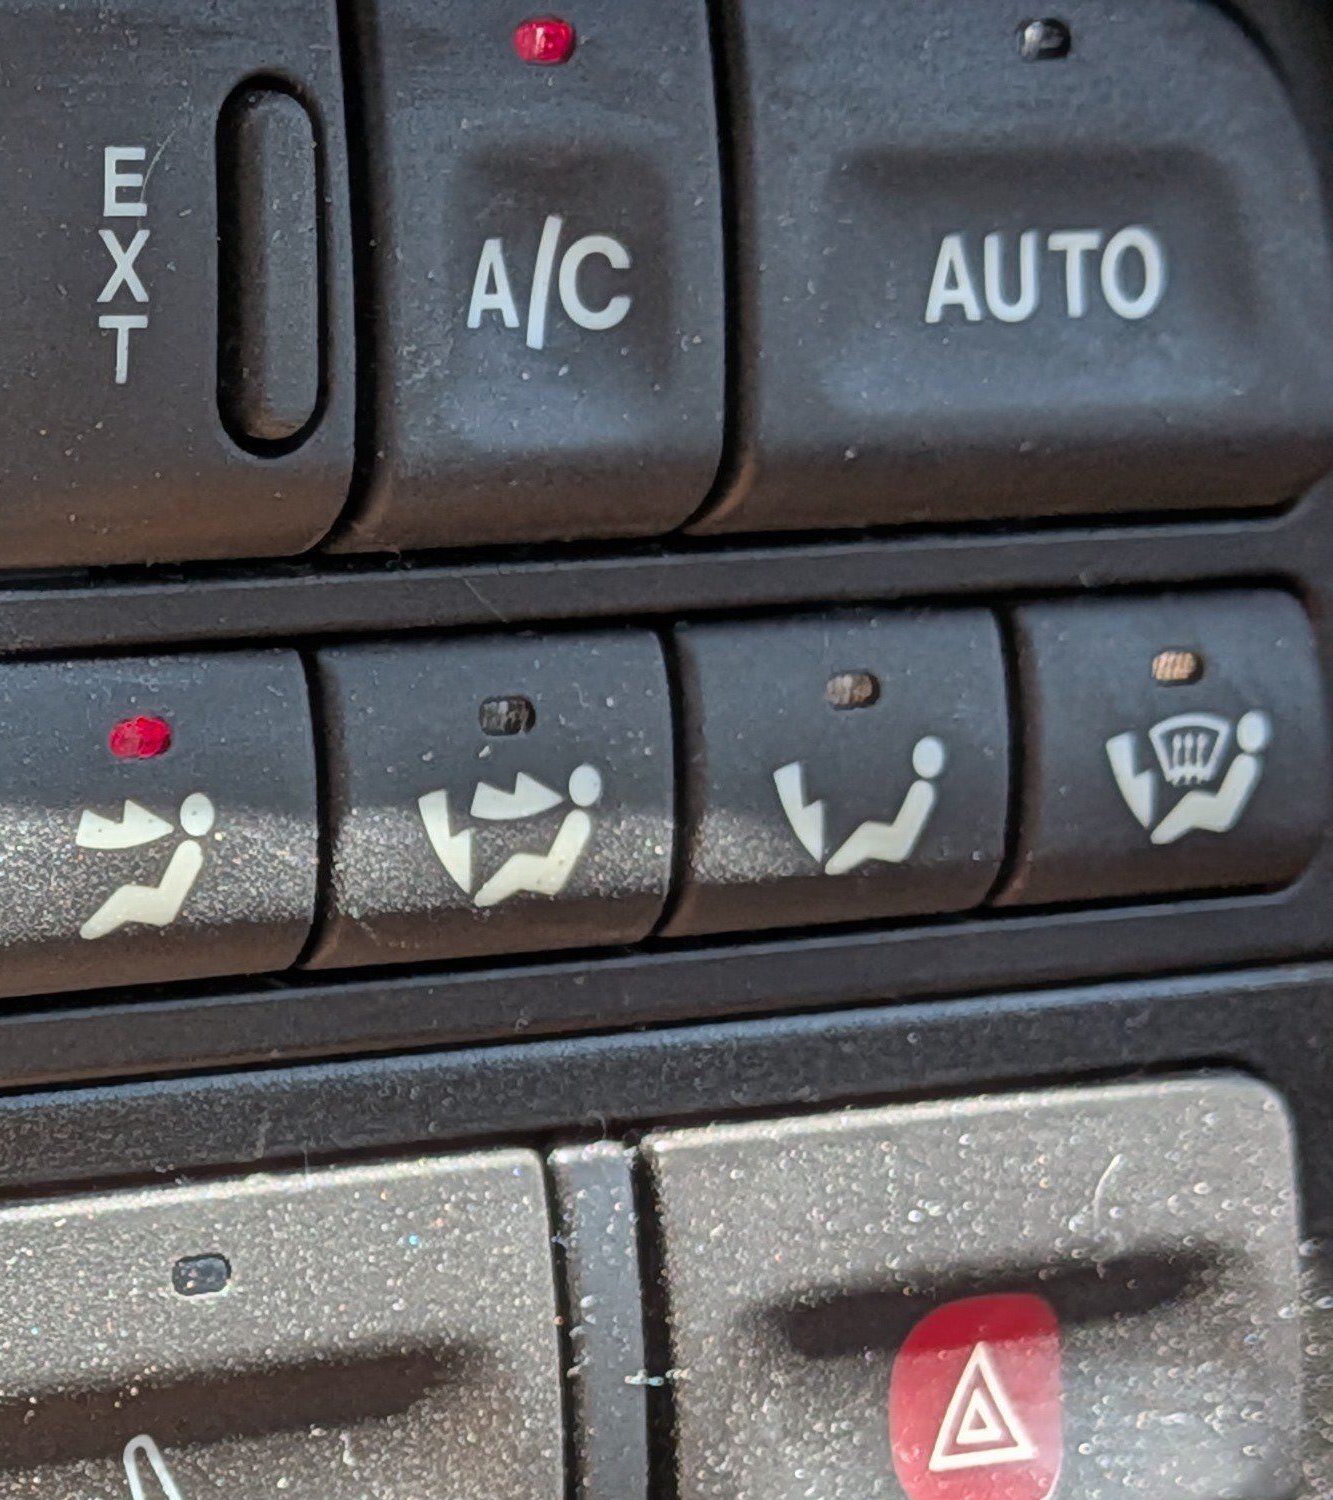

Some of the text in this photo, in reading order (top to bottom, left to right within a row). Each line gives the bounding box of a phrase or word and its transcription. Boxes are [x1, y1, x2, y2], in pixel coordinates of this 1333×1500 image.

[97, 145, 150, 384] EXT
[466, 215, 632, 350] A/C
[925, 227, 1165, 324] AUTO
